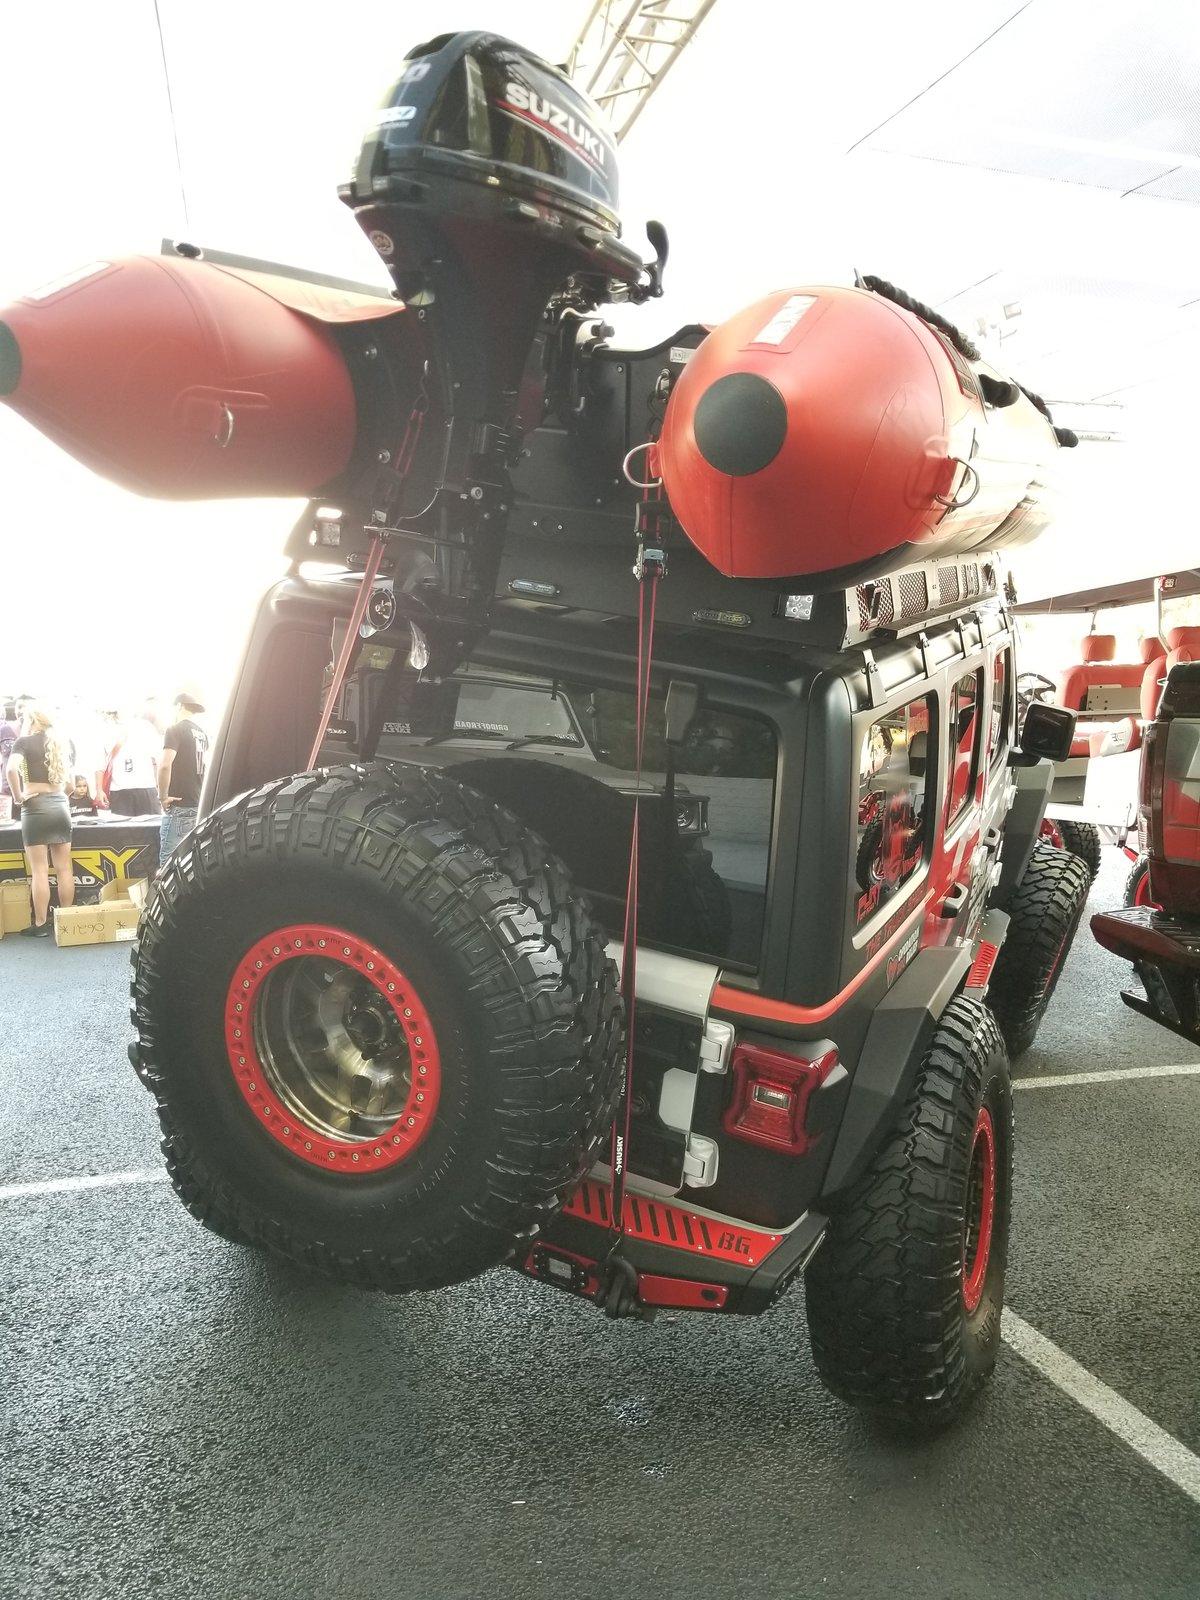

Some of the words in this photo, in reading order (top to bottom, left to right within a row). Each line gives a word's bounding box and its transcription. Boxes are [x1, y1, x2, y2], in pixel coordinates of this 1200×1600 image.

[505, 82, 605, 166] SUZUKI
[616, 1136, 624, 1167] HUSKY
[717, 1231, 751, 1255] BG
